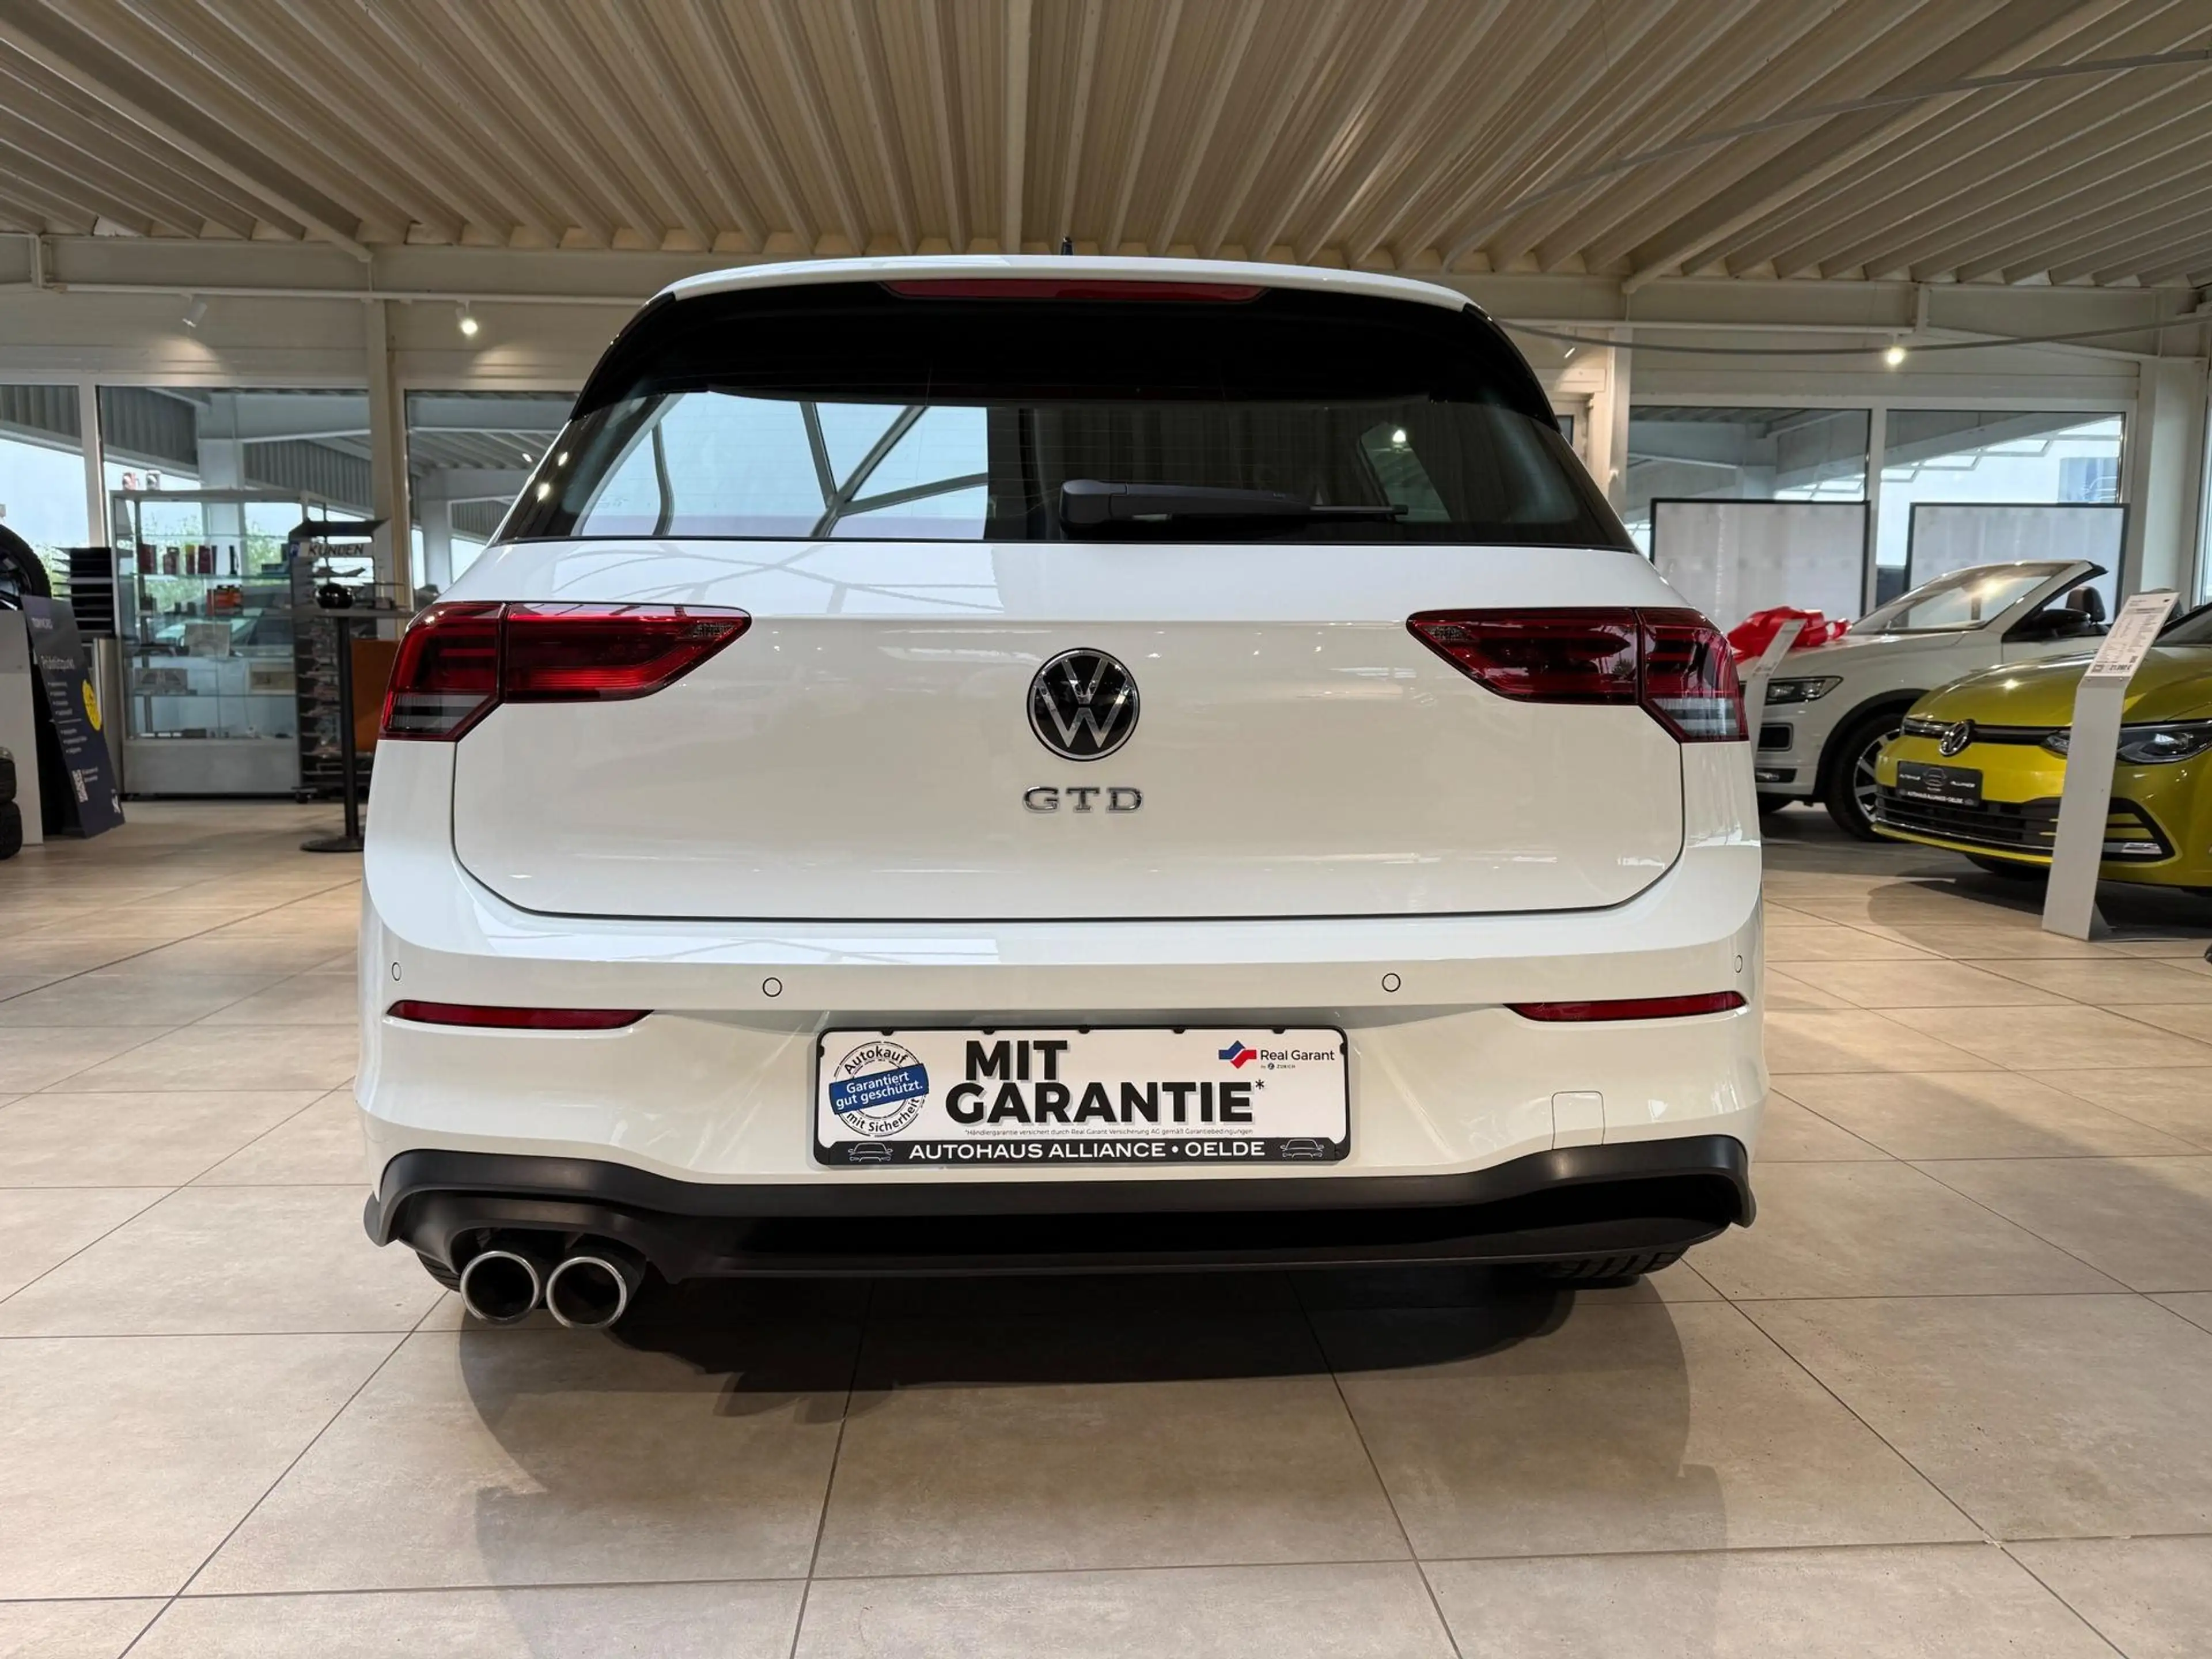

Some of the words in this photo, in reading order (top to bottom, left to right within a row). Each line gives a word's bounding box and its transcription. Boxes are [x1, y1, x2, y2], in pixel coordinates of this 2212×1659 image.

[308, 543, 364, 555] KUNDEN
[1022, 786, 1143, 813] GTD
[844, 1046, 909, 1074] Autokauf
[965, 1040, 1069, 1081] MIT
[1260, 1050, 1288, 1060] Real
[1291, 1050, 1335, 1060] Garant
[836, 1094, 858, 1109] gut
[861, 1080, 923, 1104] geschützt.
[846, 1071, 910, 1093] Garantiert
[847, 1112, 865, 1129] mit
[868, 1098, 921, 1132] Sicherheit
[909, 1142, 1043, 1160] AUTOHAUS
[1048, 1142, 1166, 1158] ALLIANCE
[1184, 1141, 1266, 1157] OELDE
